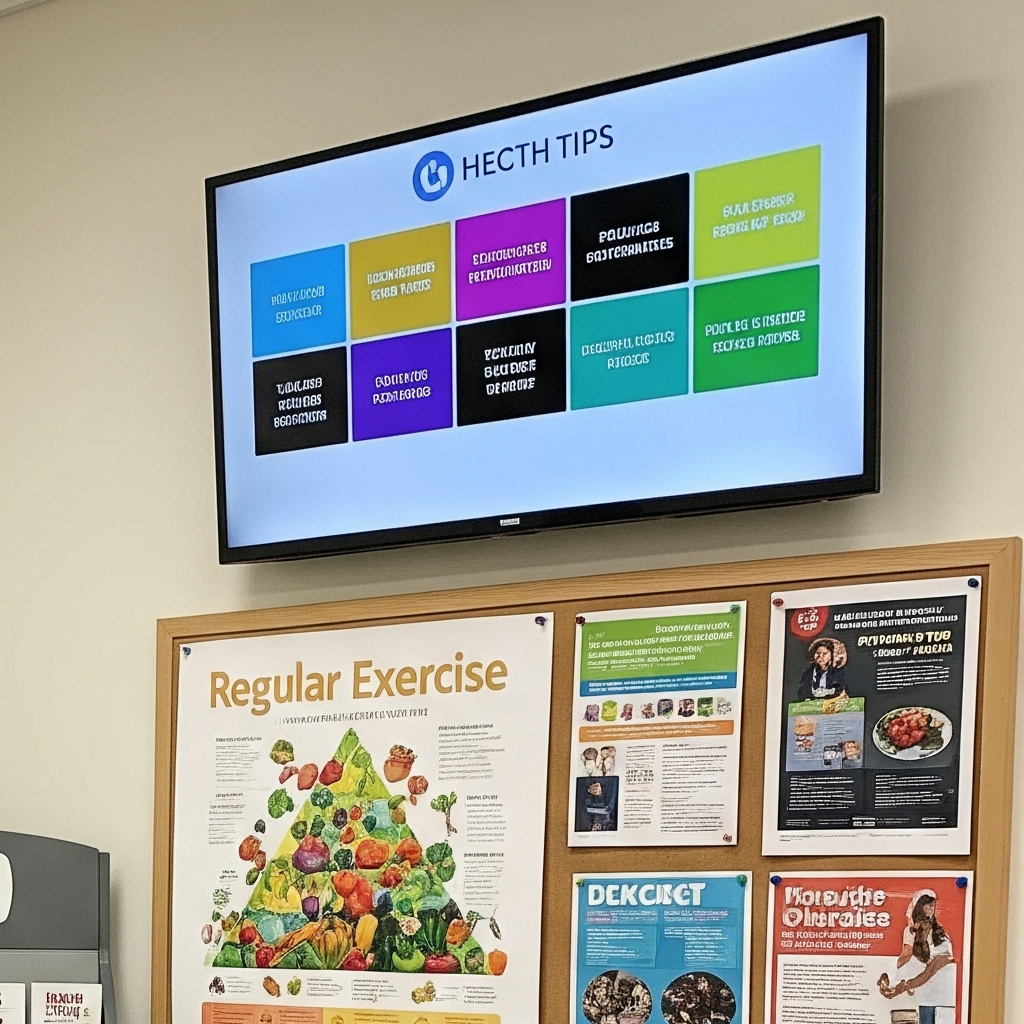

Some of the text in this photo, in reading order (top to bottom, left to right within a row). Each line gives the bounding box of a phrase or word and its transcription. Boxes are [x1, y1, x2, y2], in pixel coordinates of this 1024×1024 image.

[462, 124, 615, 180] HECTH TIPS
[209, 651, 508, 715] Regular Exercise
